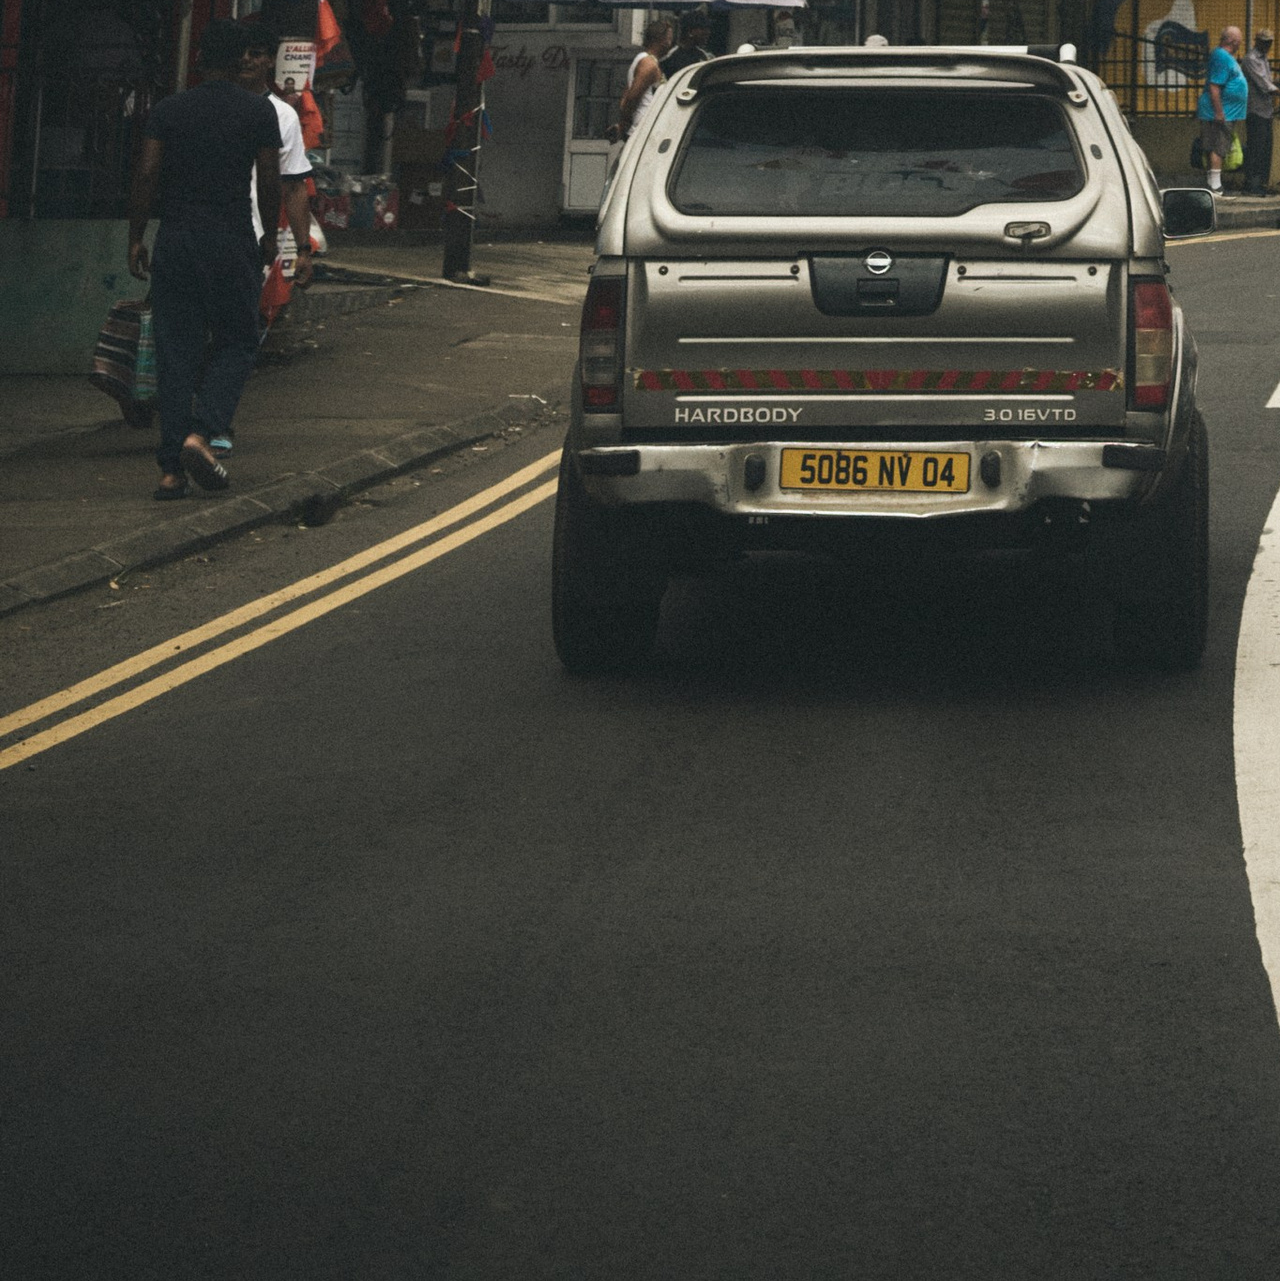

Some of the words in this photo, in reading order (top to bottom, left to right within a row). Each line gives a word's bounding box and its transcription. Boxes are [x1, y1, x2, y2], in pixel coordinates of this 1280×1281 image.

[675, 407, 803, 423] HARDBODY
[800, 453, 869, 486] 5086
[878, 455, 912, 487] NV
[922, 456, 956, 488] 04
